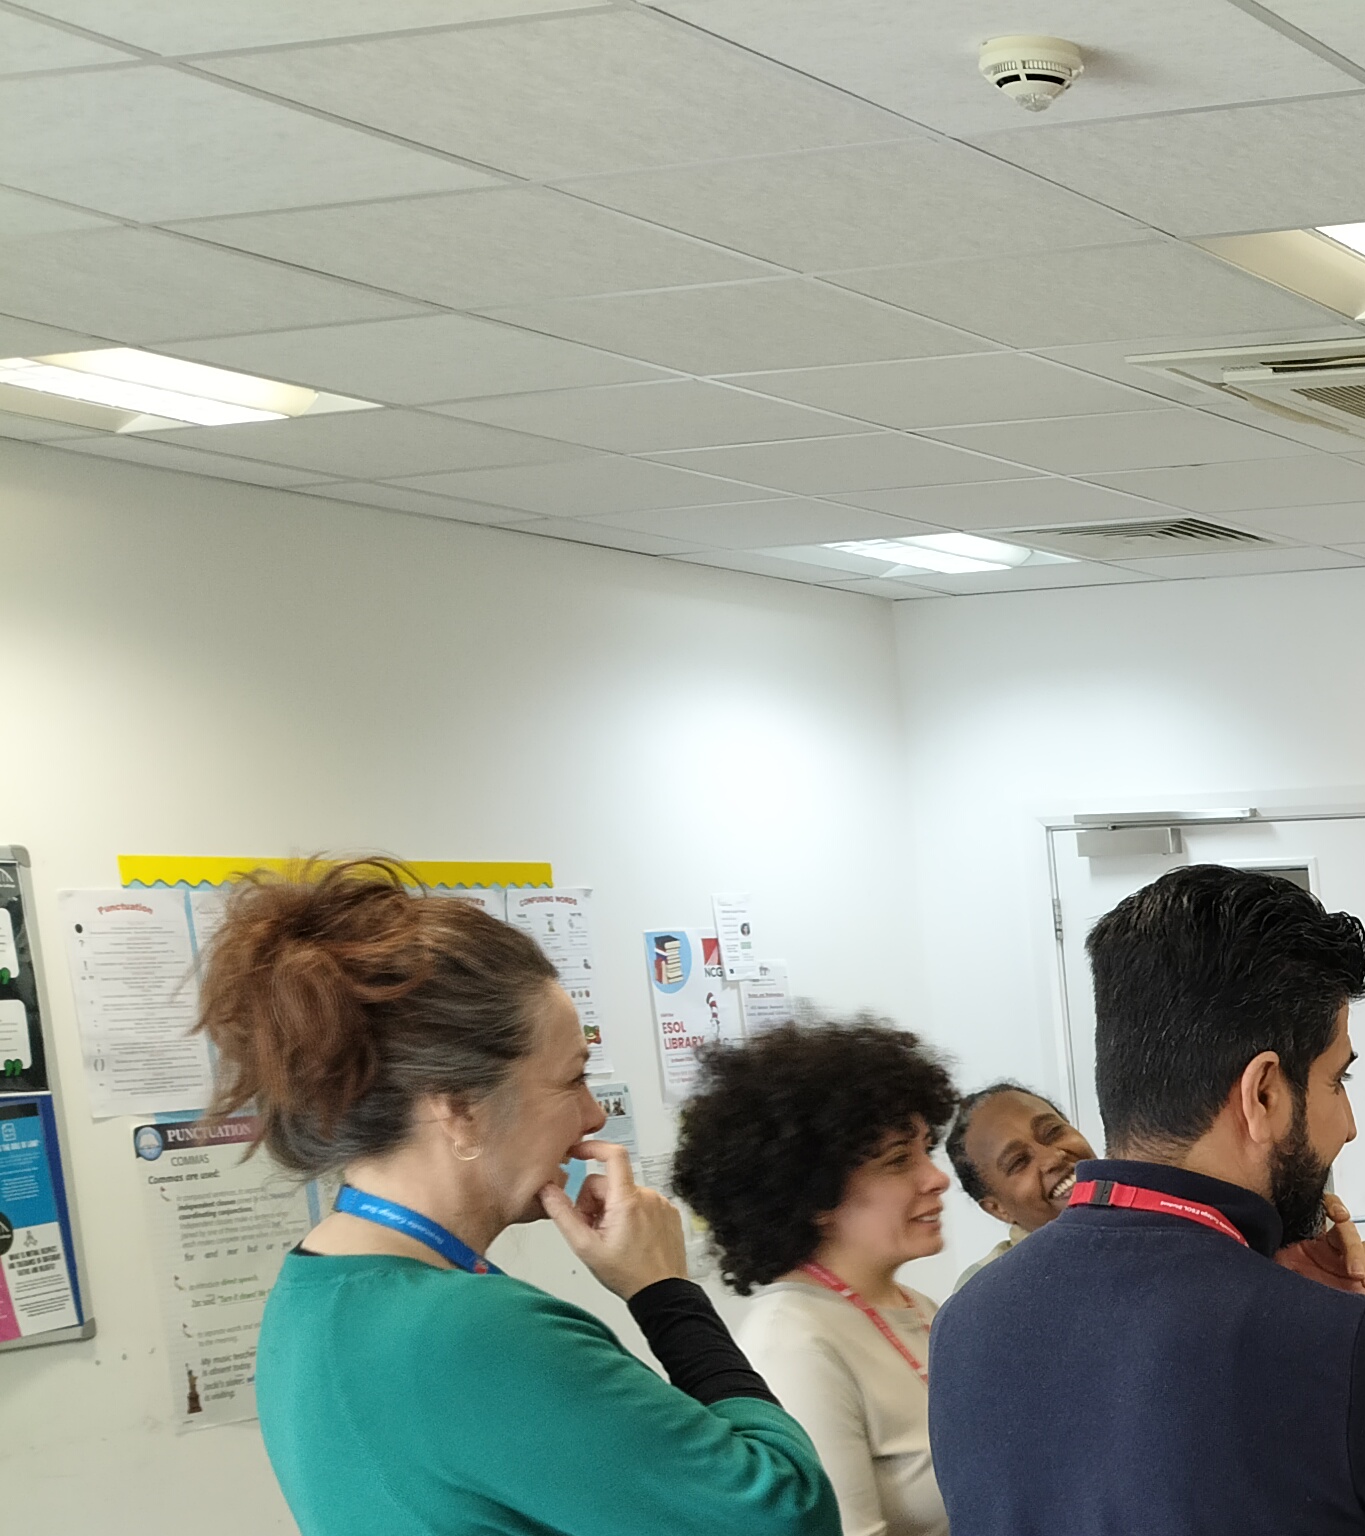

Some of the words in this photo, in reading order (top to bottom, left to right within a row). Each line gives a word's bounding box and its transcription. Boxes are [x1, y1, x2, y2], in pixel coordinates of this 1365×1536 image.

[704, 966, 724, 978] NCG
[661, 1021, 687, 1035] ESOL
[664, 1035, 705, 1050] LIBRARY
[166, 1123, 251, 1143] PUNCTUATION
[170, 1154, 209, 1167] COMMAS
[148, 1173, 183, 1184] Commas
[185, 1173, 198, 1181] are
[200, 1169, 220, 1180] used:
